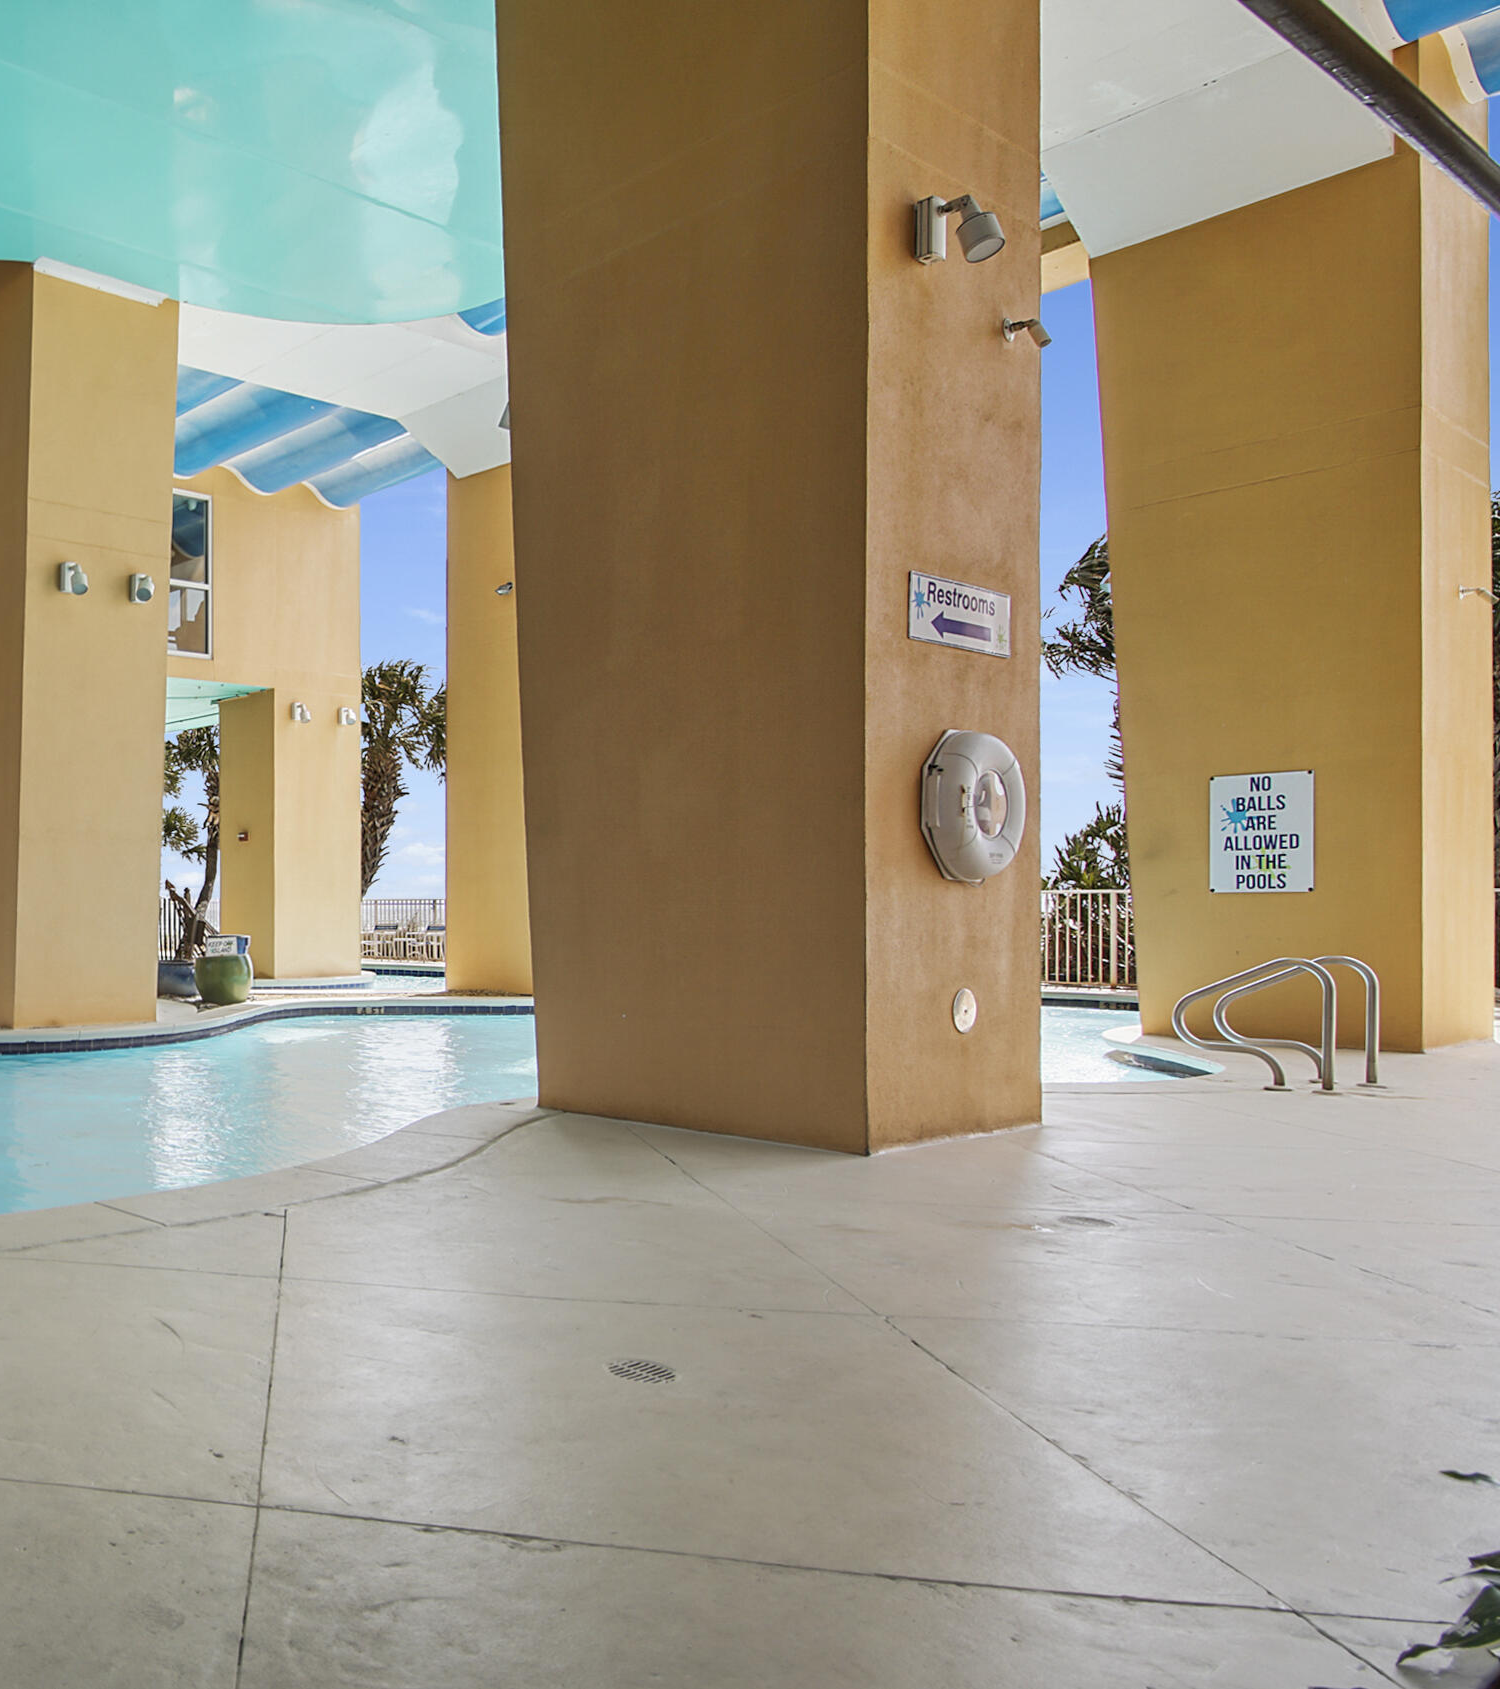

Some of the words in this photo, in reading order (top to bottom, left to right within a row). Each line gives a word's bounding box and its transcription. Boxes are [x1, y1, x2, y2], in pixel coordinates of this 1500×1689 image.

[927, 581, 996, 617] Restrooms
[1249, 776, 1272, 792] NO
[1235, 794, 1286, 812] BALLS
[1244, 815, 1277, 831] ARE
[1223, 834, 1300, 851] ALLOWED
[1235, 855, 1251, 870] IN
[1255, 853, 1287, 870] THE
[1235, 873, 1287, 890] POOLS
